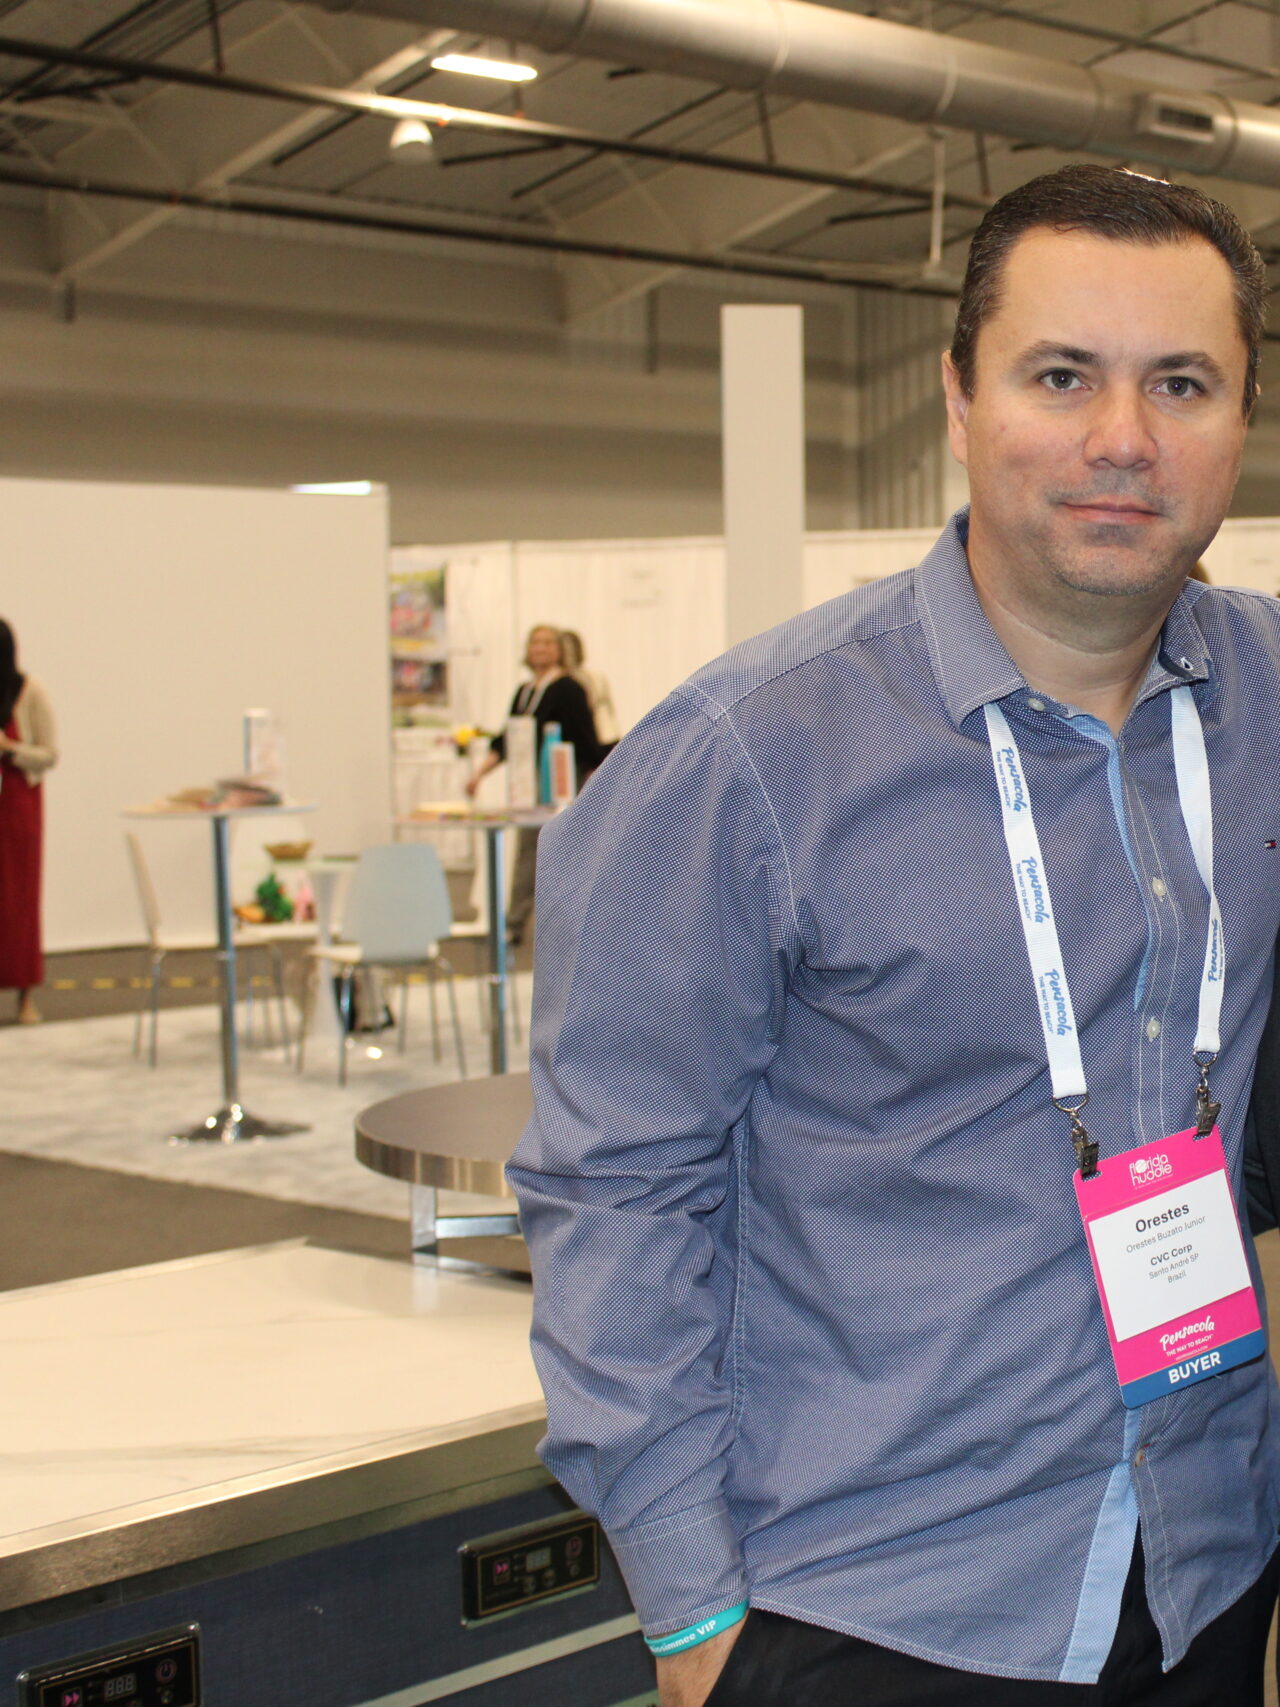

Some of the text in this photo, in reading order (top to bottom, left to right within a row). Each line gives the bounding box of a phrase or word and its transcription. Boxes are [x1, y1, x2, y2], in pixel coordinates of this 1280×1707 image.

[1001, 747, 1028, 812] Pensacola
[1022, 856, 1050, 923] Pensacola
[1044, 968, 1072, 1036] Pensacola
[1132, 1163, 1173, 1186] huddle
[1135, 1204, 1190, 1233] Orestes
[1126, 1236, 1157, 1253] Orestes
[1184, 1216, 1206, 1231] Junior
[1150, 1244, 1193, 1266] CVC Corp
[1189, 1253, 1199, 1262] SP
[1167, 1270, 1187, 1283] Brazil
[1160, 1315, 1215, 1351] Pensacola
[1168, 1351, 1222, 1384] BUYER
[696, 1619, 717, 1636] VIP
